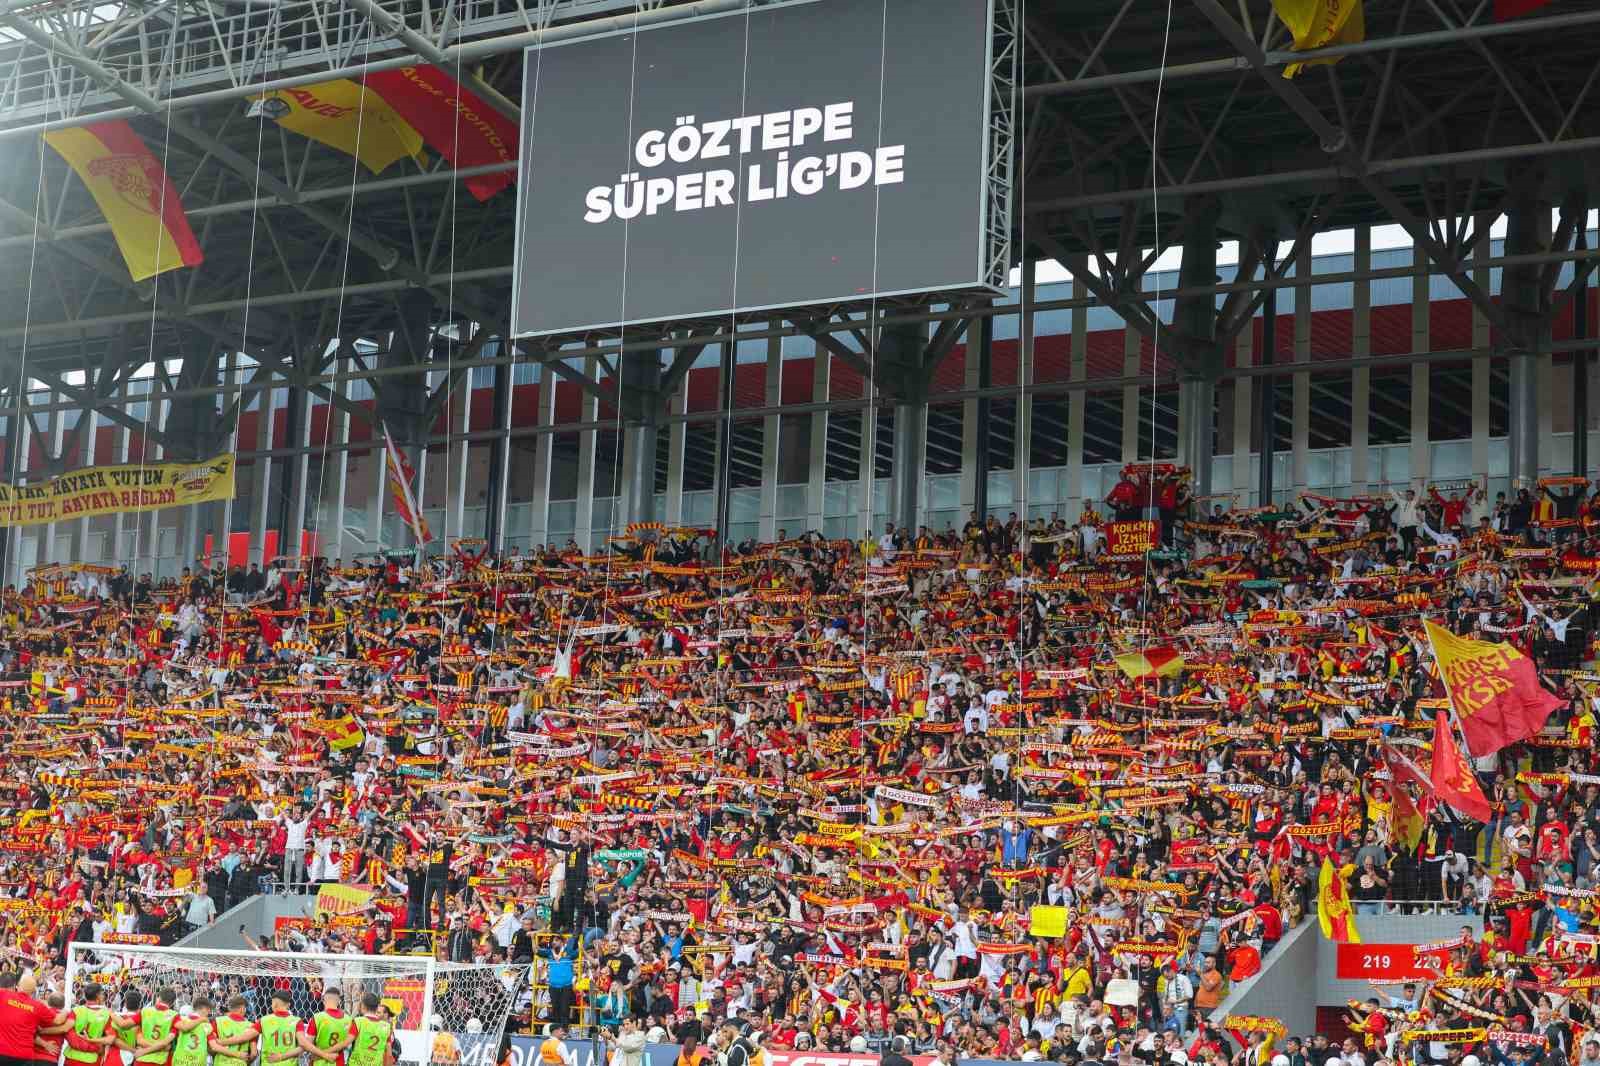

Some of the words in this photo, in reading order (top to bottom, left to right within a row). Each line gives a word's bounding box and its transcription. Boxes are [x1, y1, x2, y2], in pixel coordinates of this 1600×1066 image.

[635, 101, 853, 167] GÖZTEPE
[583, 169, 735, 223] SÜPER
[748, 144, 905, 202] LİG'DE
[110, 469, 163, 486] TUTUN
[887, 790, 931, 804] GÖZTEPE
[1363, 954, 1391, 969] 219
[187, 1033, 199, 1051] 3
[273, 1030, 293, 1048] 10
[367, 1035, 380, 1051] 2
